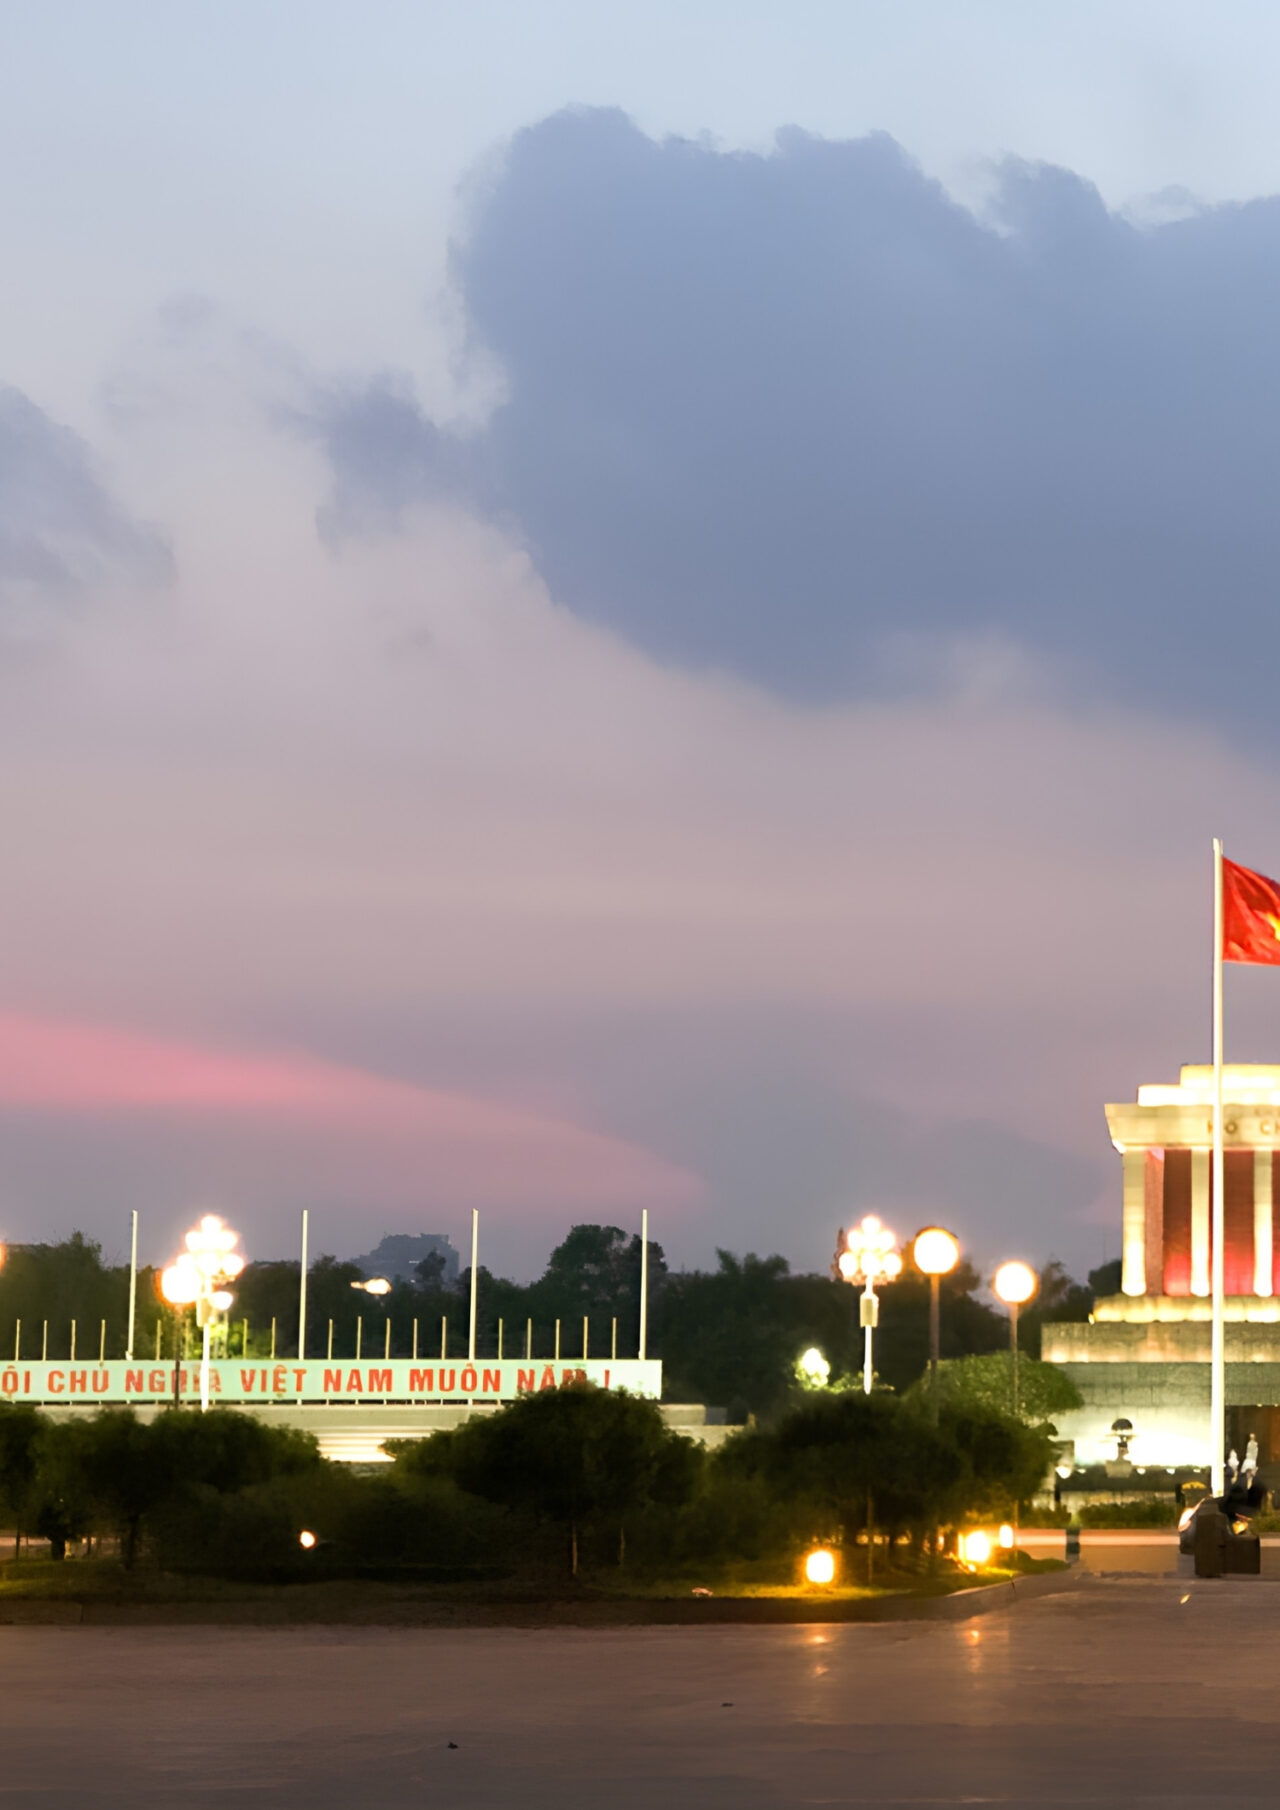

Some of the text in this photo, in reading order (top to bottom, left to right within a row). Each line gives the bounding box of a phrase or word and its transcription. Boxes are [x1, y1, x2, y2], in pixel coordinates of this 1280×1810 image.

[240, 1364, 307, 1398] VIỆT
[323, 1368, 393, 1393] NAM
[409, 1362, 500, 1393] MUÔN
